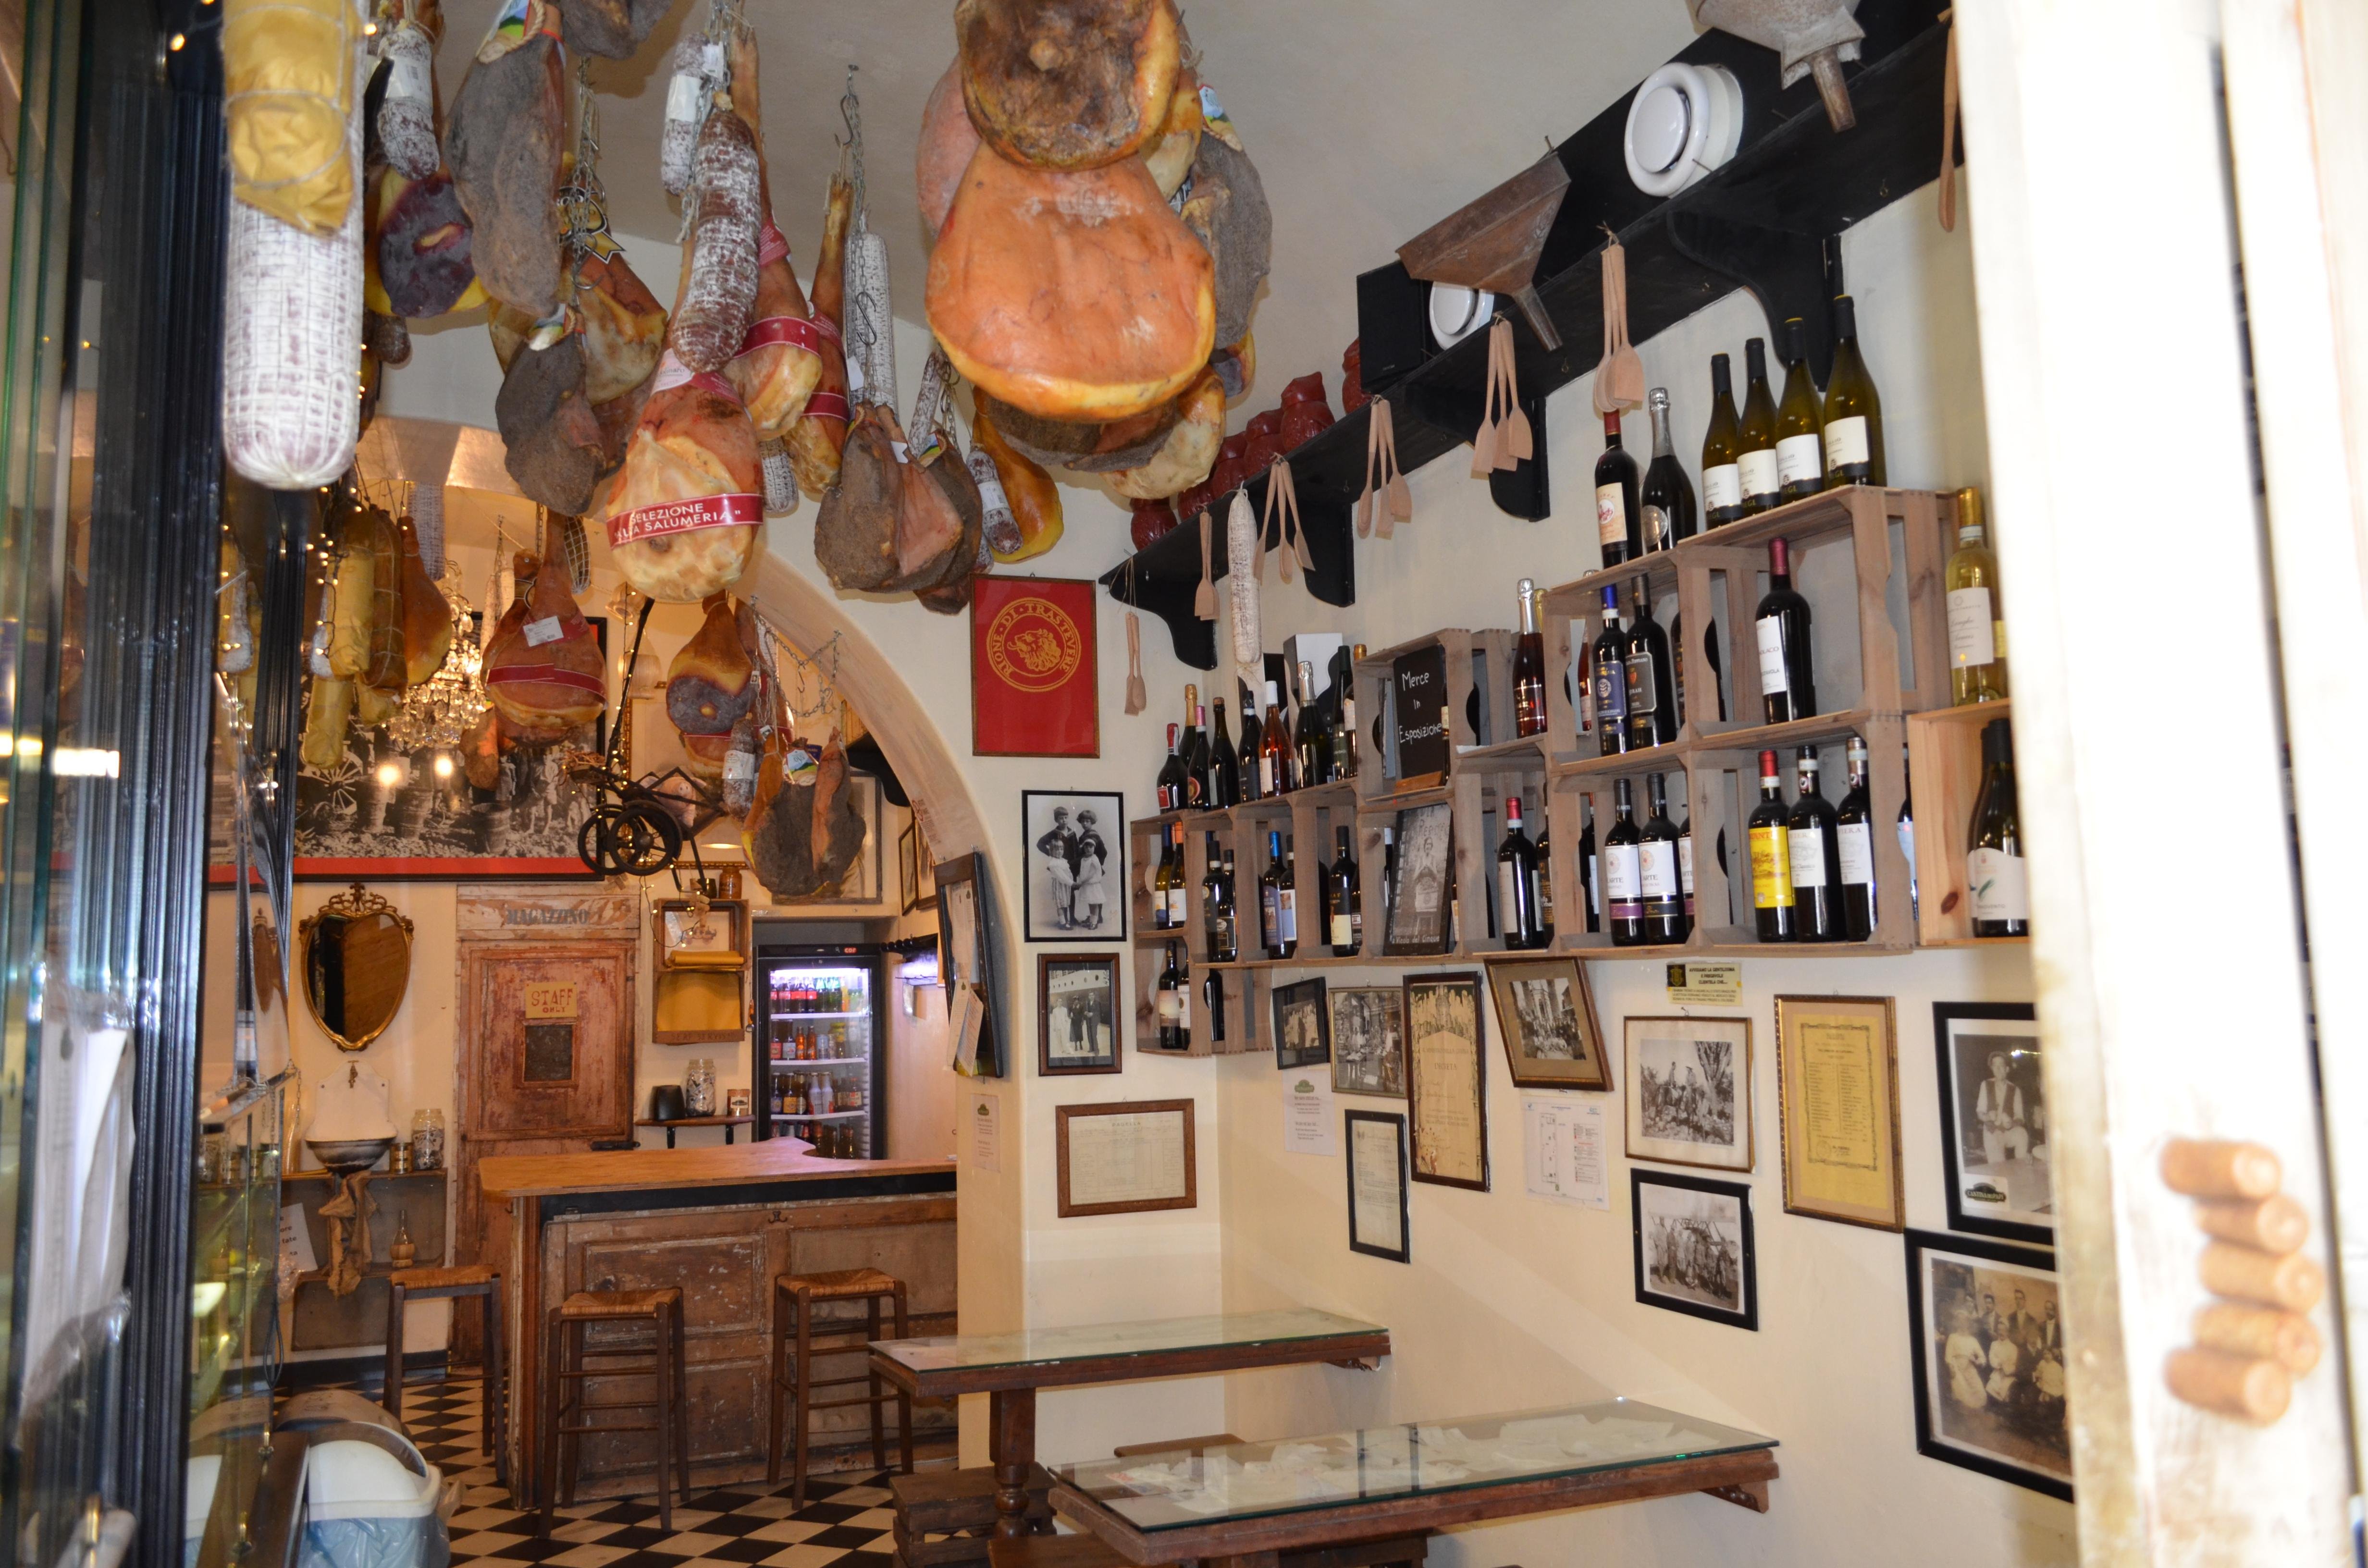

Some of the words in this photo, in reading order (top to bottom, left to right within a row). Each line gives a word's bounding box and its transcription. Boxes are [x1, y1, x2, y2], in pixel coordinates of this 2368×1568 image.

[630, 503, 703, 524] SELEZIONE
[1000, 608, 1019, 625] DI
[993, 634, 1013, 675] RIONE
[1402, 671, 1430, 691] Merce
[1399, 723, 1442, 745] Esposizione
[506, 908, 589, 925] MAGAZZINO
[531, 989, 573, 1006] STAFF
